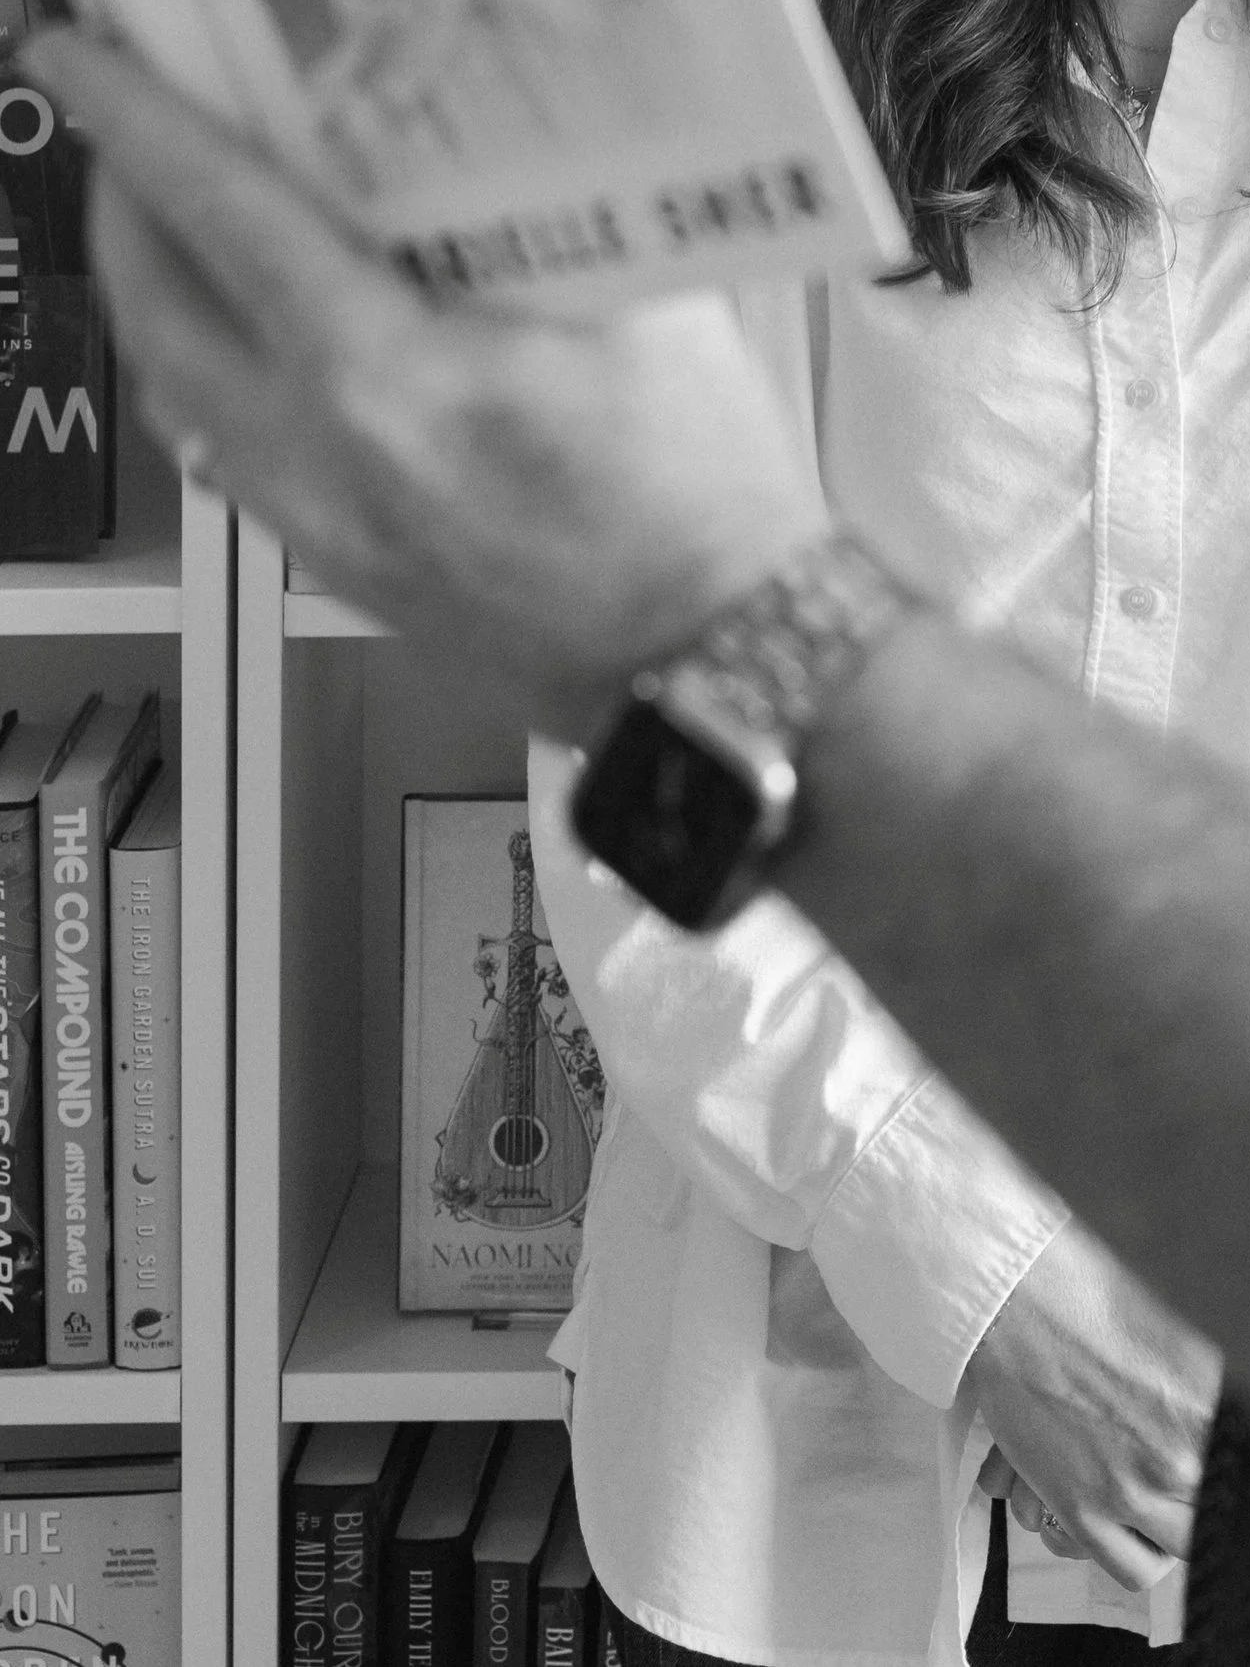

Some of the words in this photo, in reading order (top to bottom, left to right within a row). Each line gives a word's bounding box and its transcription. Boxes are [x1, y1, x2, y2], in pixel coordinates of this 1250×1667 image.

[54, 808, 88, 884] THE
[131, 877, 150, 915] THE
[131, 924, 151, 975] IRON
[55, 892, 93, 1129] COMPOUND
[133, 986, 153, 1071] GARDEN
[134, 1079, 155, 1150] SUTRA
[66, 1225, 88, 1294] RAWLE
[136, 1255, 156, 1290] SUI
[432, 1244, 532, 1269] NAOMI
[295, 1512, 309, 1532] the
[334, 1512, 364, 1589] BURY
[409, 1570, 432, 1633] EMILY
[489, 1579, 510, 1663] BLOOD
